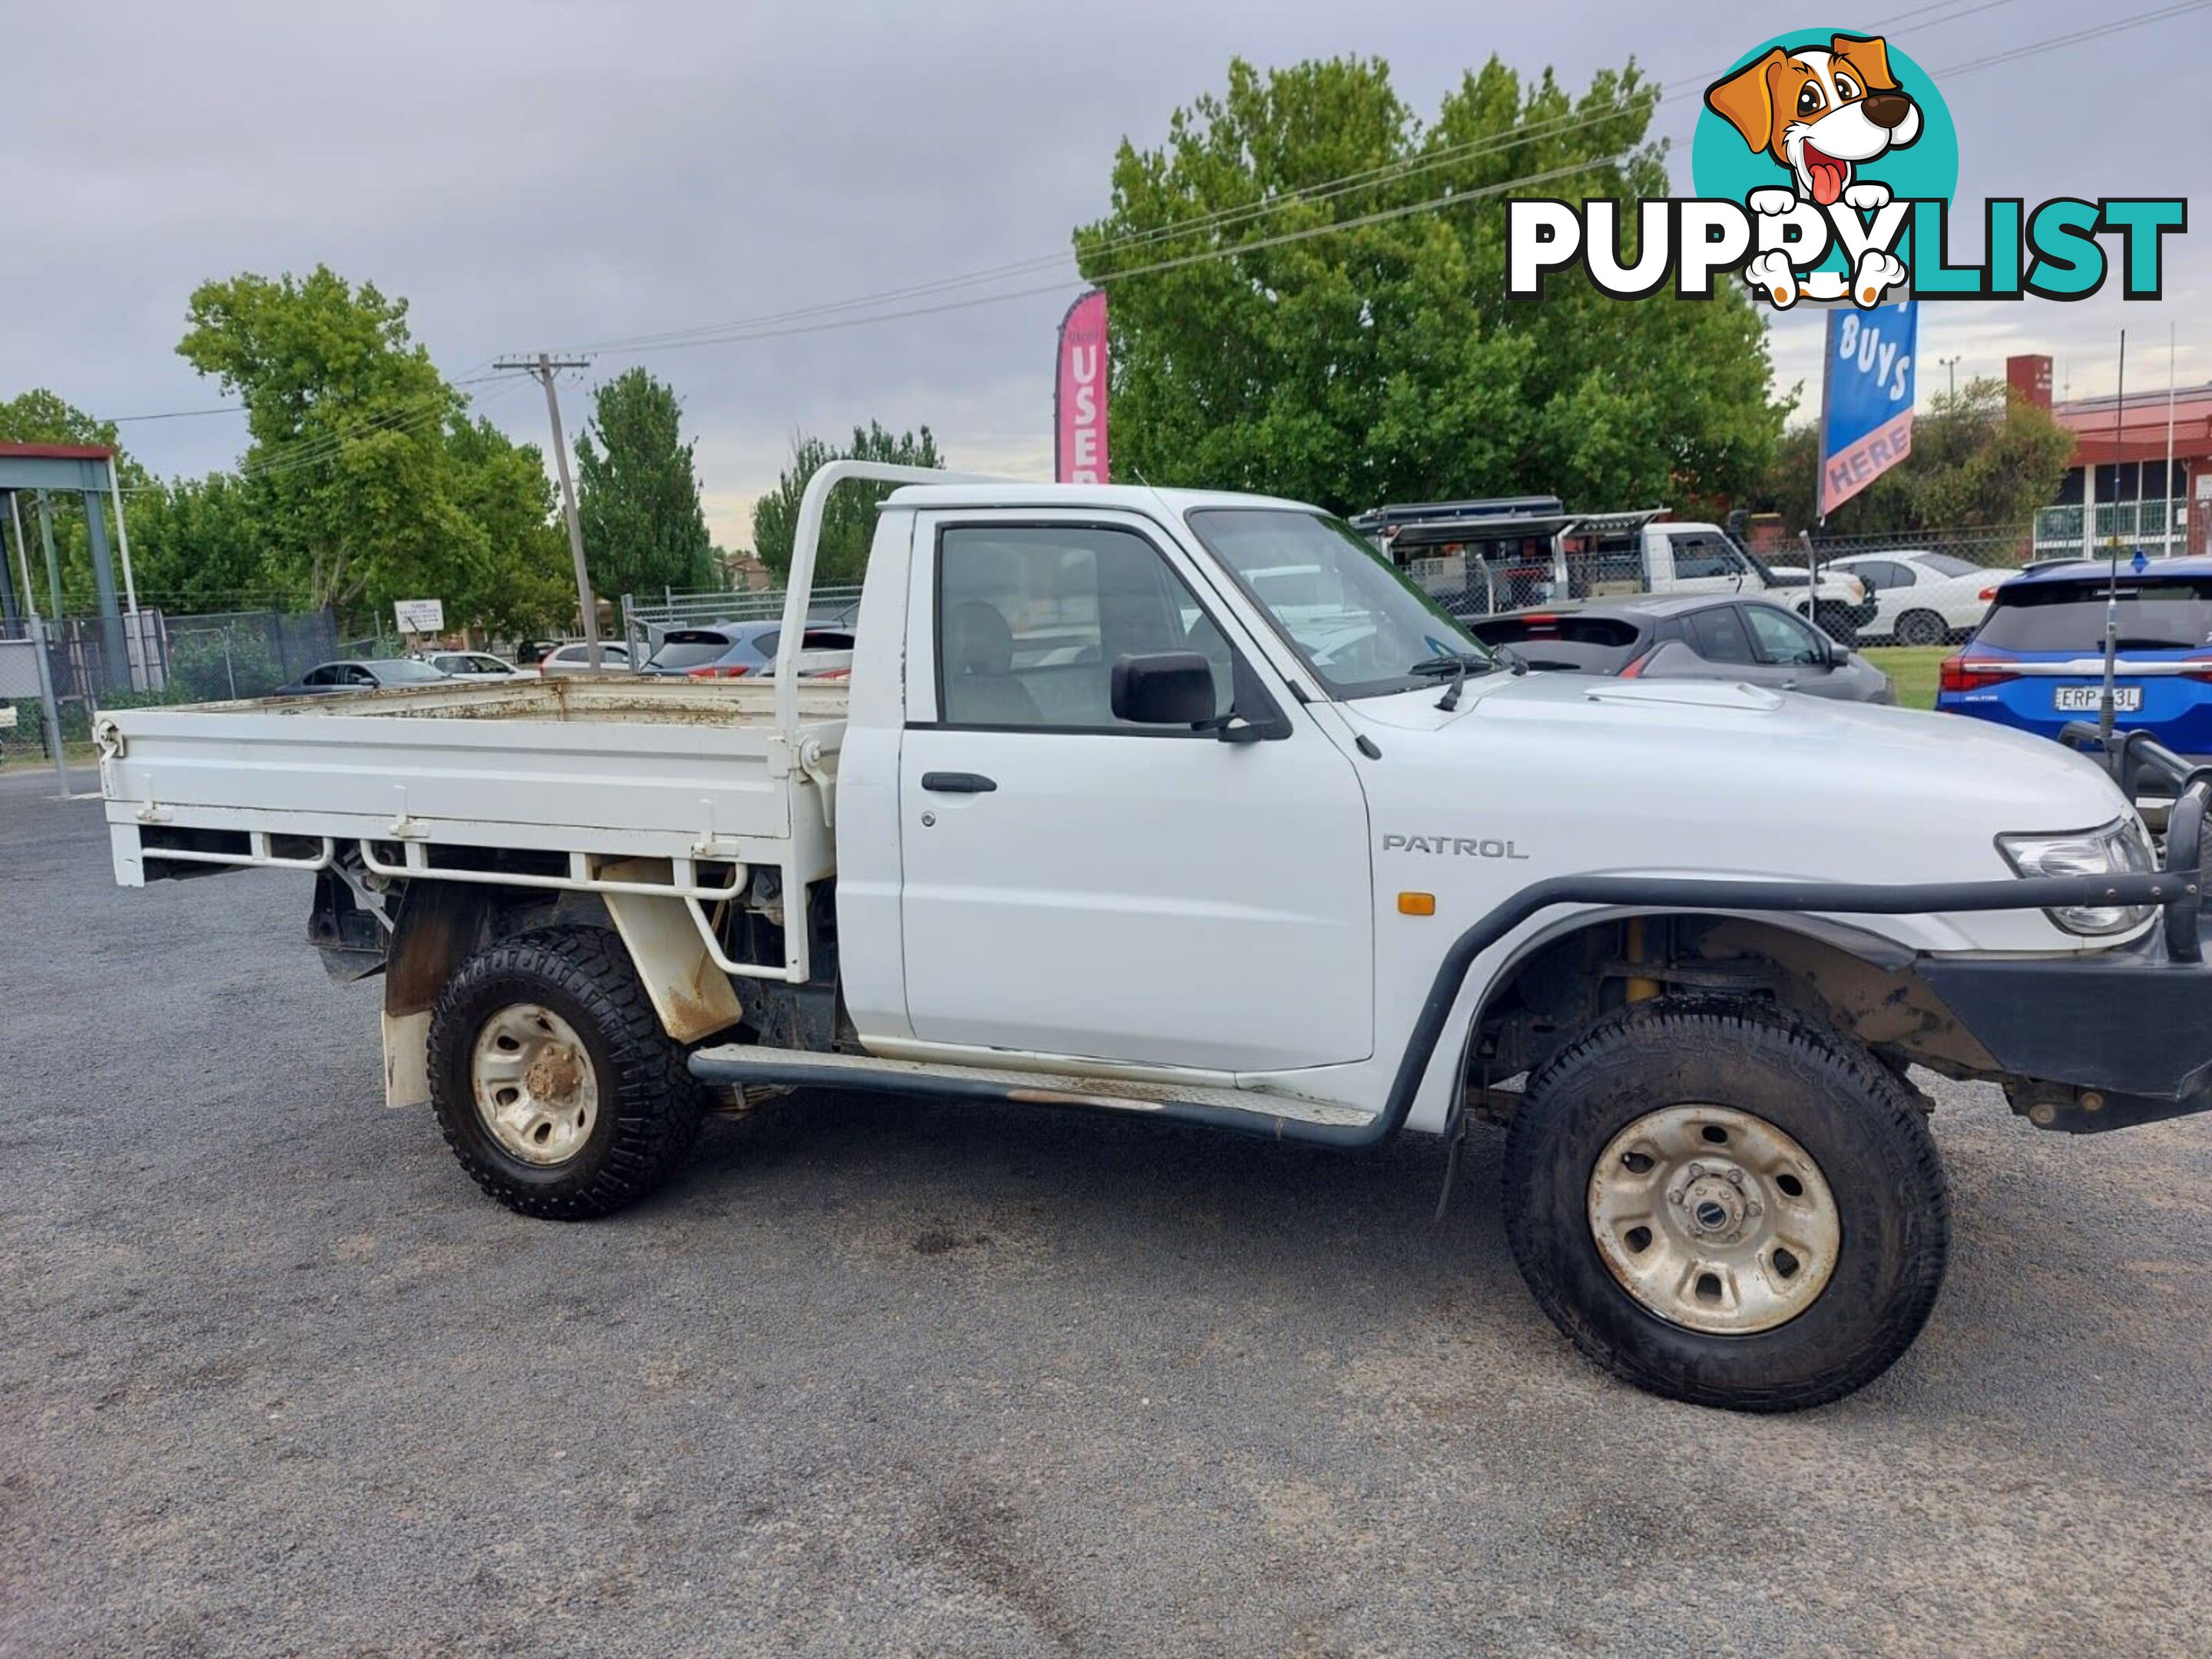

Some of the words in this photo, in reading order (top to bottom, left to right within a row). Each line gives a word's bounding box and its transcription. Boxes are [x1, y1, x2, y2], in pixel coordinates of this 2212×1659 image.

[1839, 313, 1910, 401] BUYS
[1830, 425, 1908, 494] HERE
[1383, 834, 1529, 859] PATROL
